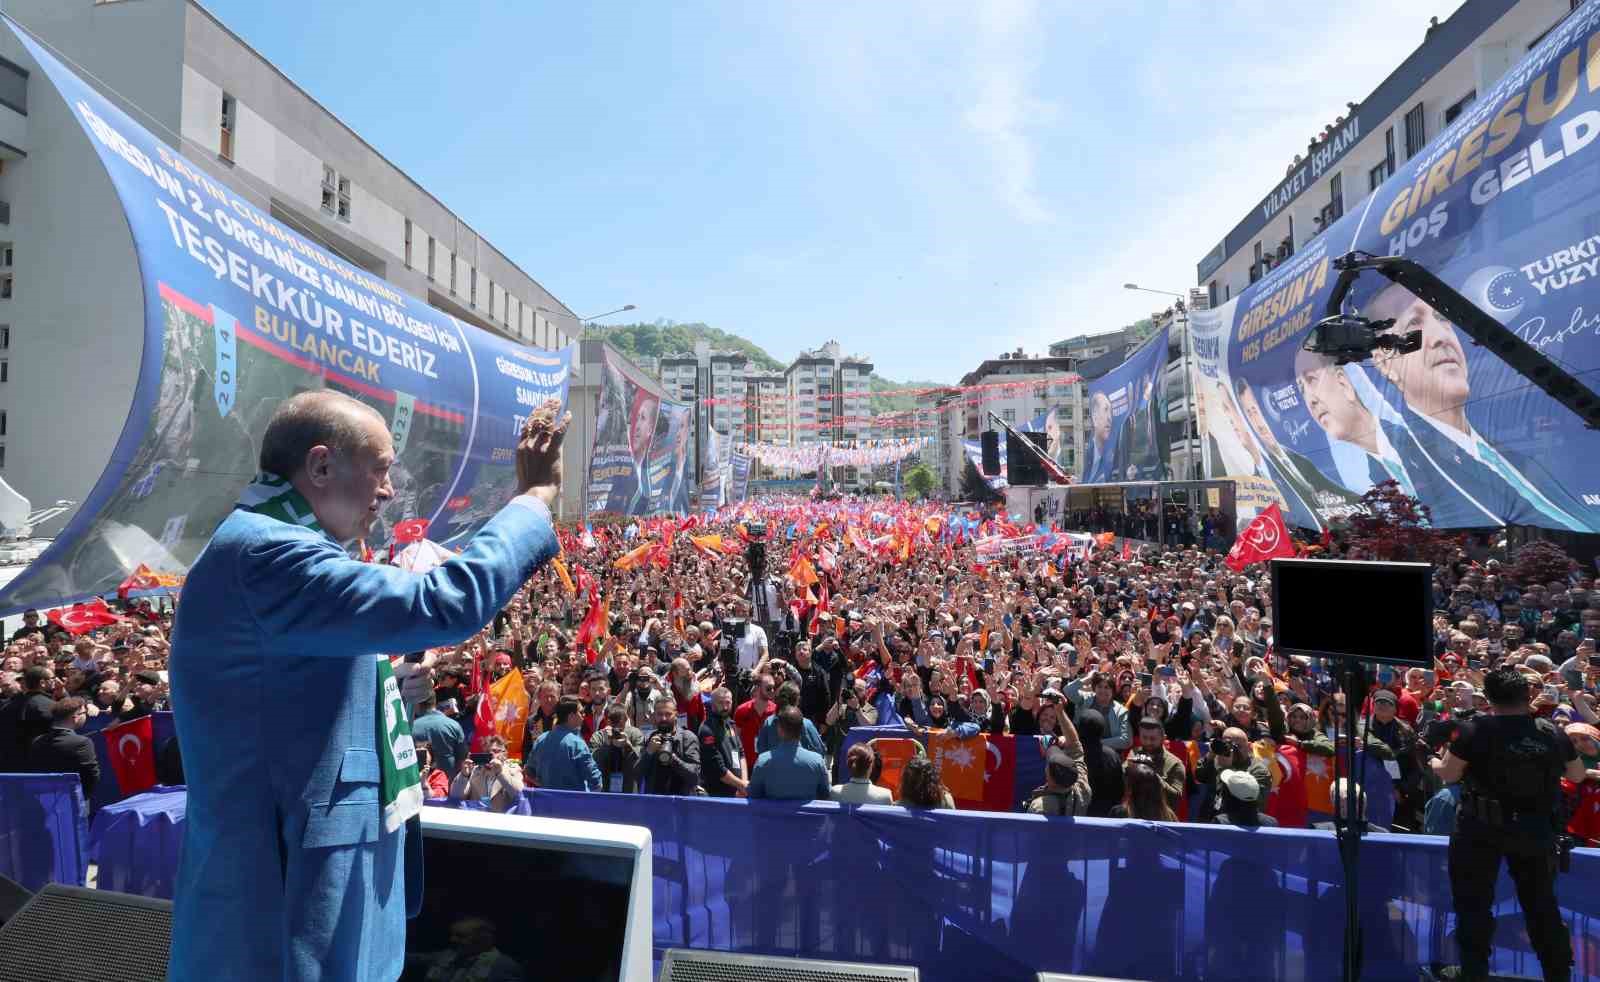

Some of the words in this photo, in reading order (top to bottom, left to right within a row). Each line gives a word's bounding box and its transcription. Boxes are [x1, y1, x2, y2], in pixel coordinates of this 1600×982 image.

[1263, 165, 1308, 219] VİLAYET
[1388, 201, 1449, 257] HOŞ
[156, 197, 346, 342] TEŞEKKÜR
[350, 318, 439, 379] EDERİZ
[213, 208, 323, 291] ORGANİZE
[321, 273, 383, 321] SANAYİ
[219, 327, 232, 405] 2014
[254, 305, 381, 384] BULANCAK
